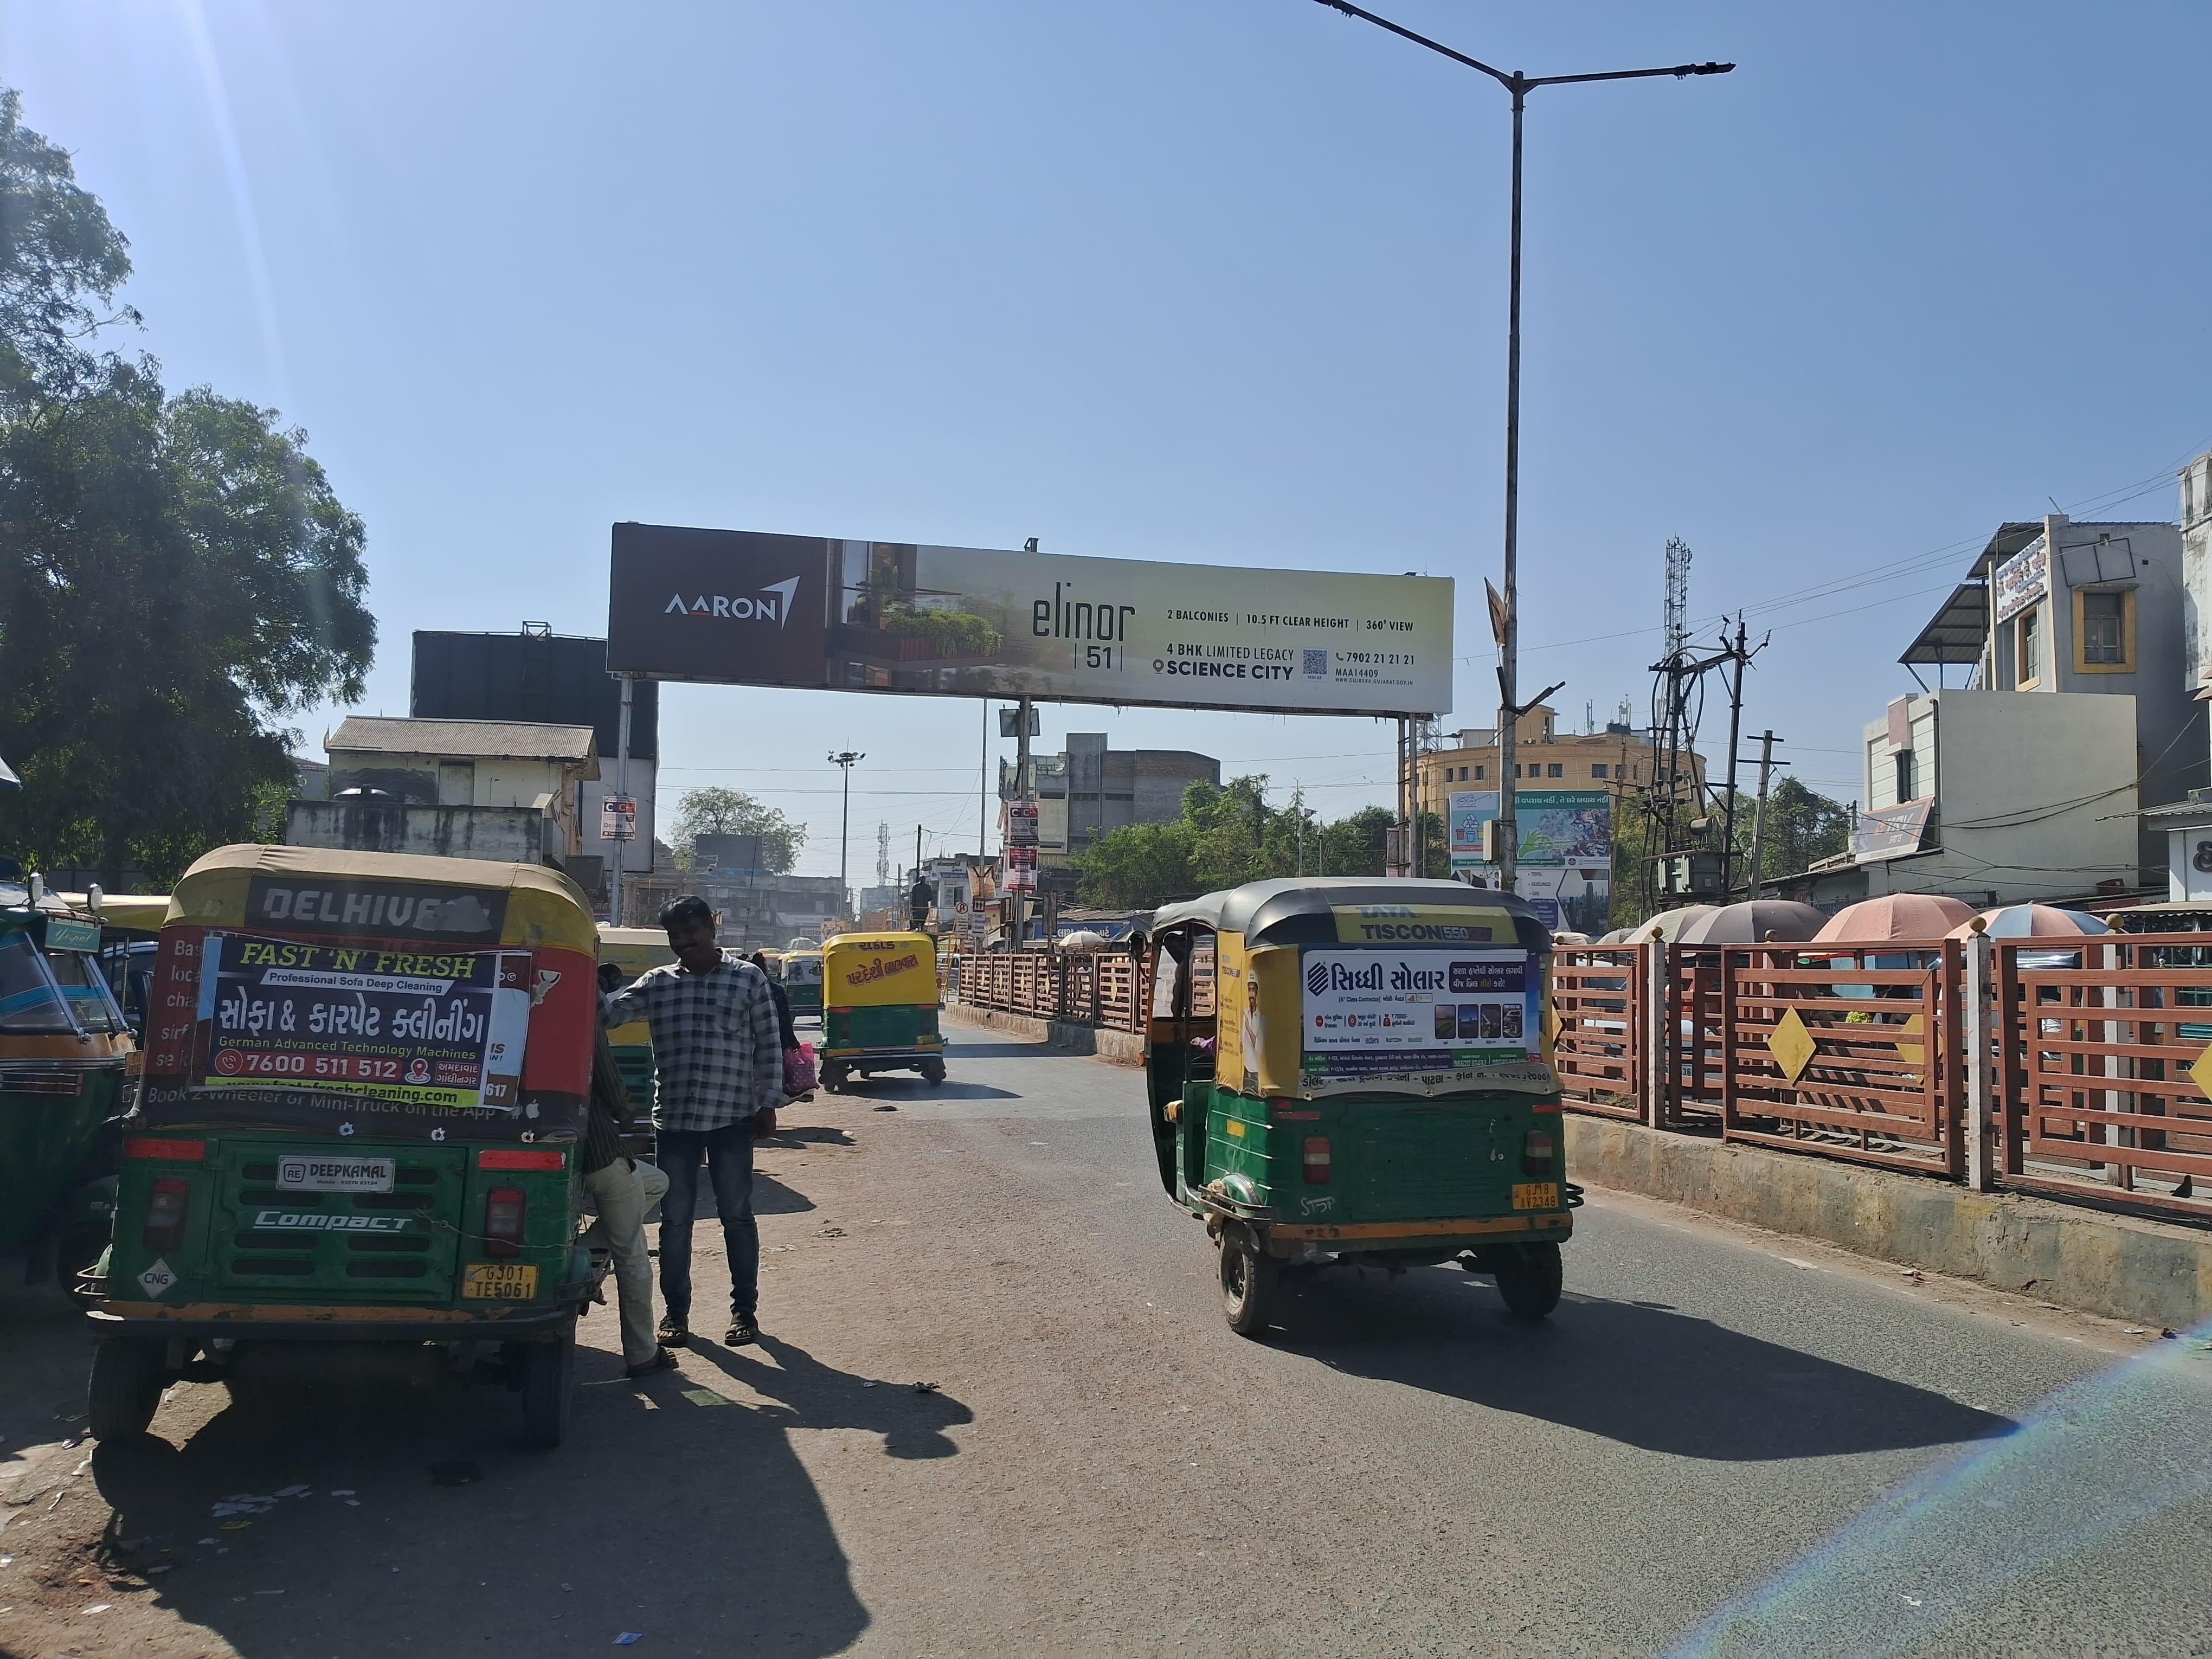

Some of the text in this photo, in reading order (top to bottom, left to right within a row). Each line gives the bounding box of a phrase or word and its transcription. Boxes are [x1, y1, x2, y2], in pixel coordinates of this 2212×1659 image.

[665, 593, 776, 621] AARON
[1033, 582, 1136, 641] elinor
[1168, 610, 1229, 622] 2 BALCONIES
[1247, 614, 1349, 629] 10.5 FT CLEAR HEIGHT
[1390, 621, 1414, 632] VIEW
[1167, 643, 1295, 661] 4 BHK LIMITED LEGACY
[1347, 652, 1414, 665] 7902 21 21 21
[1167, 660, 1294, 680] SCIENCE CITY
[1336, 668, 1378, 678] MAA14409
[263, 889, 491, 929] DELHIVE
[1357, 906, 1419, 918] TATA
[1361, 924, 1443, 940] TISCON
[240, 942, 320, 967] FAST
[376, 953, 477, 978] FRESH
[269, 973, 442, 994] Professional Sofa Deep Cleaning
[1391, 962, 1444, 991] સોલાર
[219, 986, 274, 1037] સોફા
[280, 998, 295, 1031] &
[309, 993, 380, 1037] કારપેટ
[218, 1036, 476, 1059] German Advanced Technology Machines
[1365, 1036, 1379, 1044] adani
[247, 1054, 396, 1078] 7600 511 512
[438, 1063, 479, 1073] અમદાવાદ
[437, 1073, 478, 1085] ગાંધીનગર
[148, 1088, 187, 1103] Book
[287, 1094, 304, 1105] or
[311, 1094, 399, 1113] Mini-Truck
[405, 1103, 426, 1115] on
[288, 1170, 301, 1178] RE
[310, 1164, 386, 1179] DEEPKAMAL
[144, 1274, 169, 1284] CNG
[476, 1282, 530, 1298] TE5061
